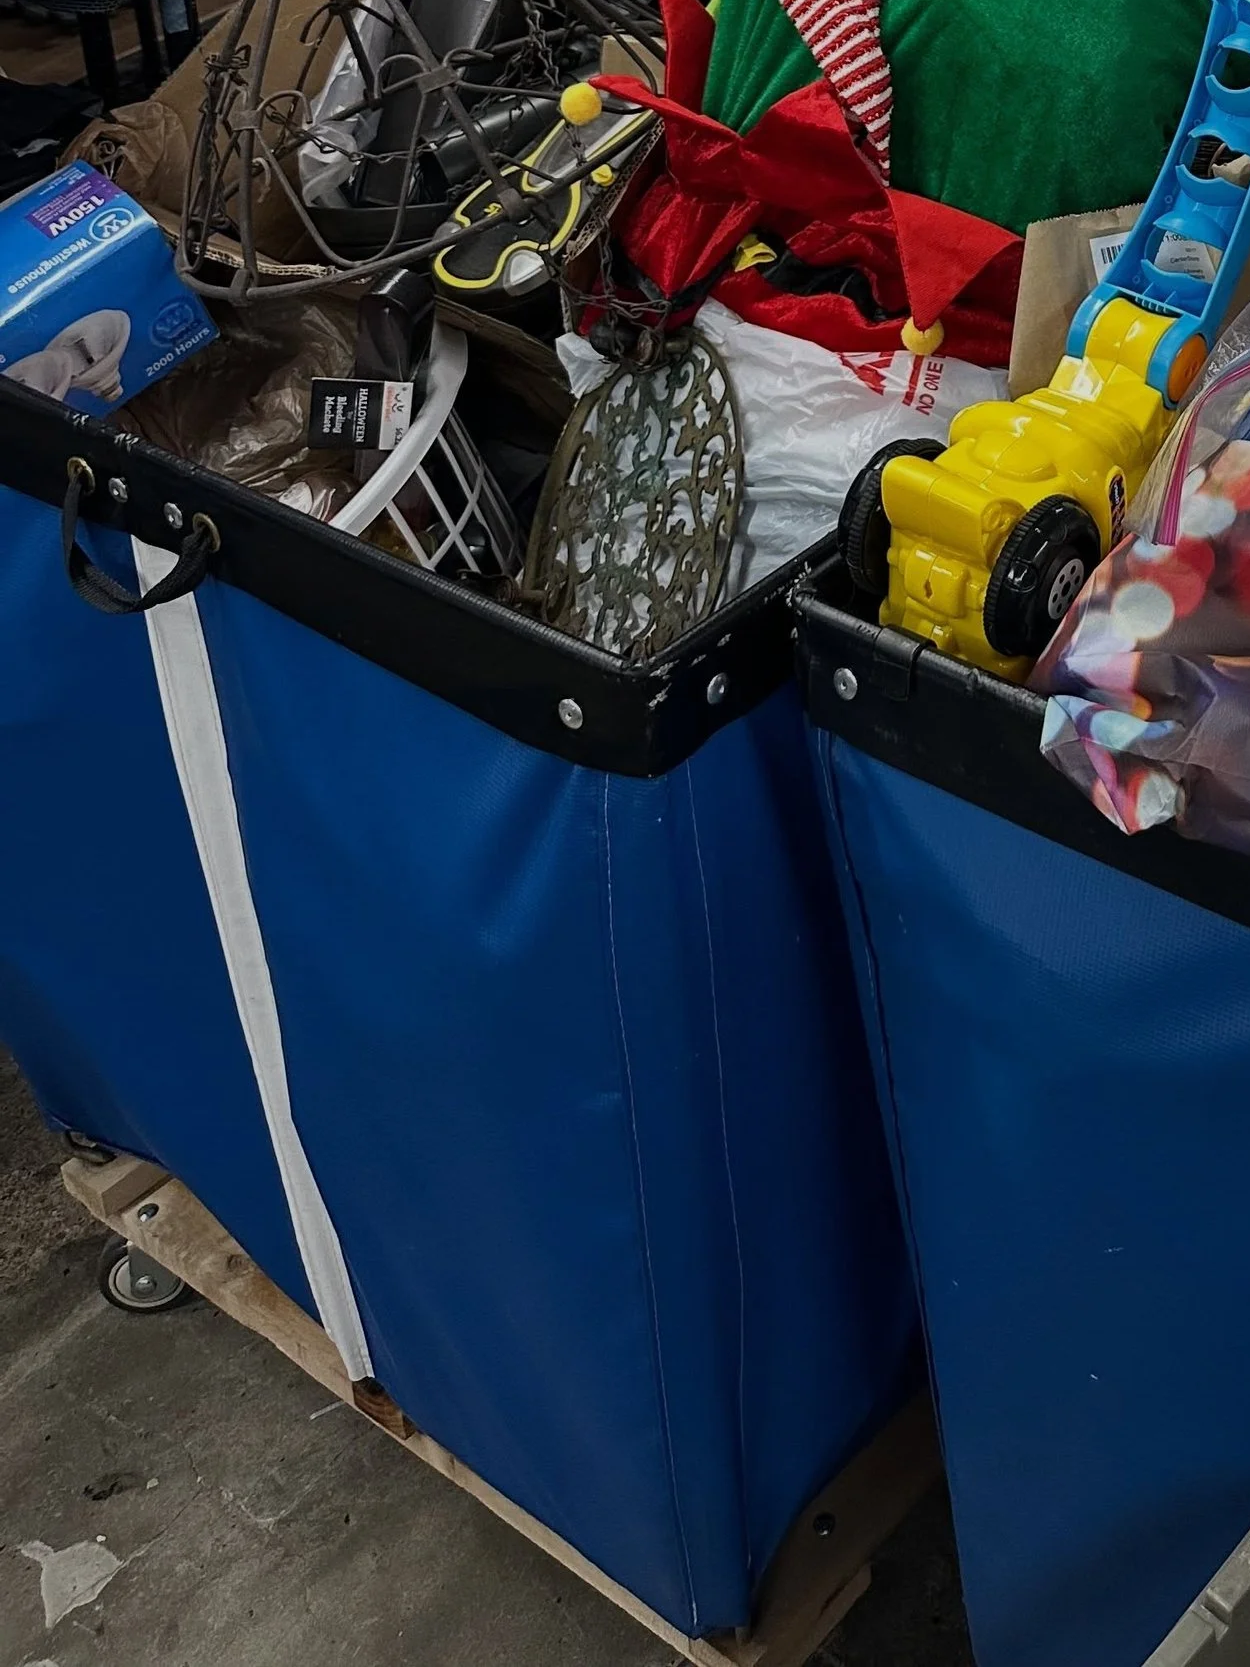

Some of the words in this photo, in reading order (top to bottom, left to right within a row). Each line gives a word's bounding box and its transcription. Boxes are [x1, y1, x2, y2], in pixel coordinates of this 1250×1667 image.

[48, 195, 105, 238] 150W
[7, 237, 92, 295] Westinghouse
[146, 351, 174, 377] 2000
[175, 326, 210, 357] Hours
[924, 361, 944, 391] ONE
[322, 395, 336, 434] Machete
[332, 395, 348, 434] Bleeding
[355, 387, 369, 443] HALLOWEEN
